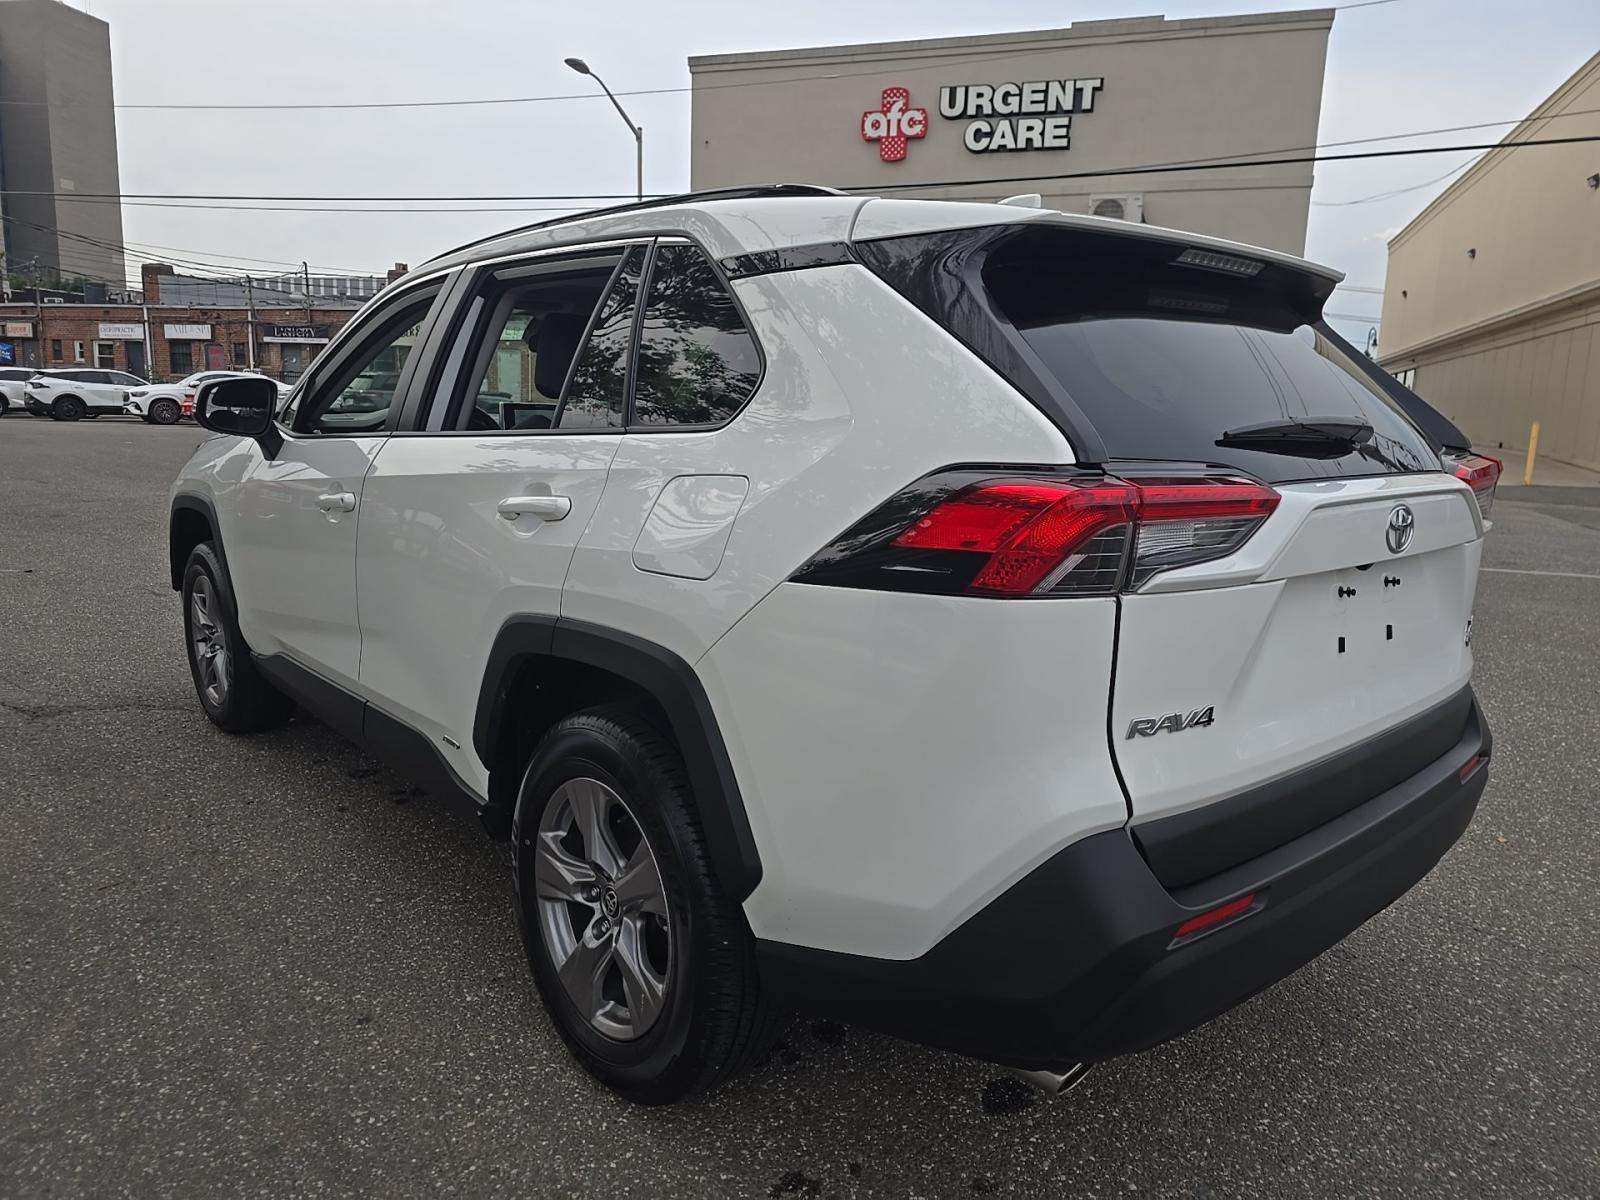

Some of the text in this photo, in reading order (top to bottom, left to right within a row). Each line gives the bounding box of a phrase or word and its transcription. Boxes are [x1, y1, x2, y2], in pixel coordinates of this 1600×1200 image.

[864, 98, 925, 138] afc
[938, 77, 1104, 120] URGENT
[963, 116, 1072, 154] CARE
[1126, 704, 1215, 740] RAV4
